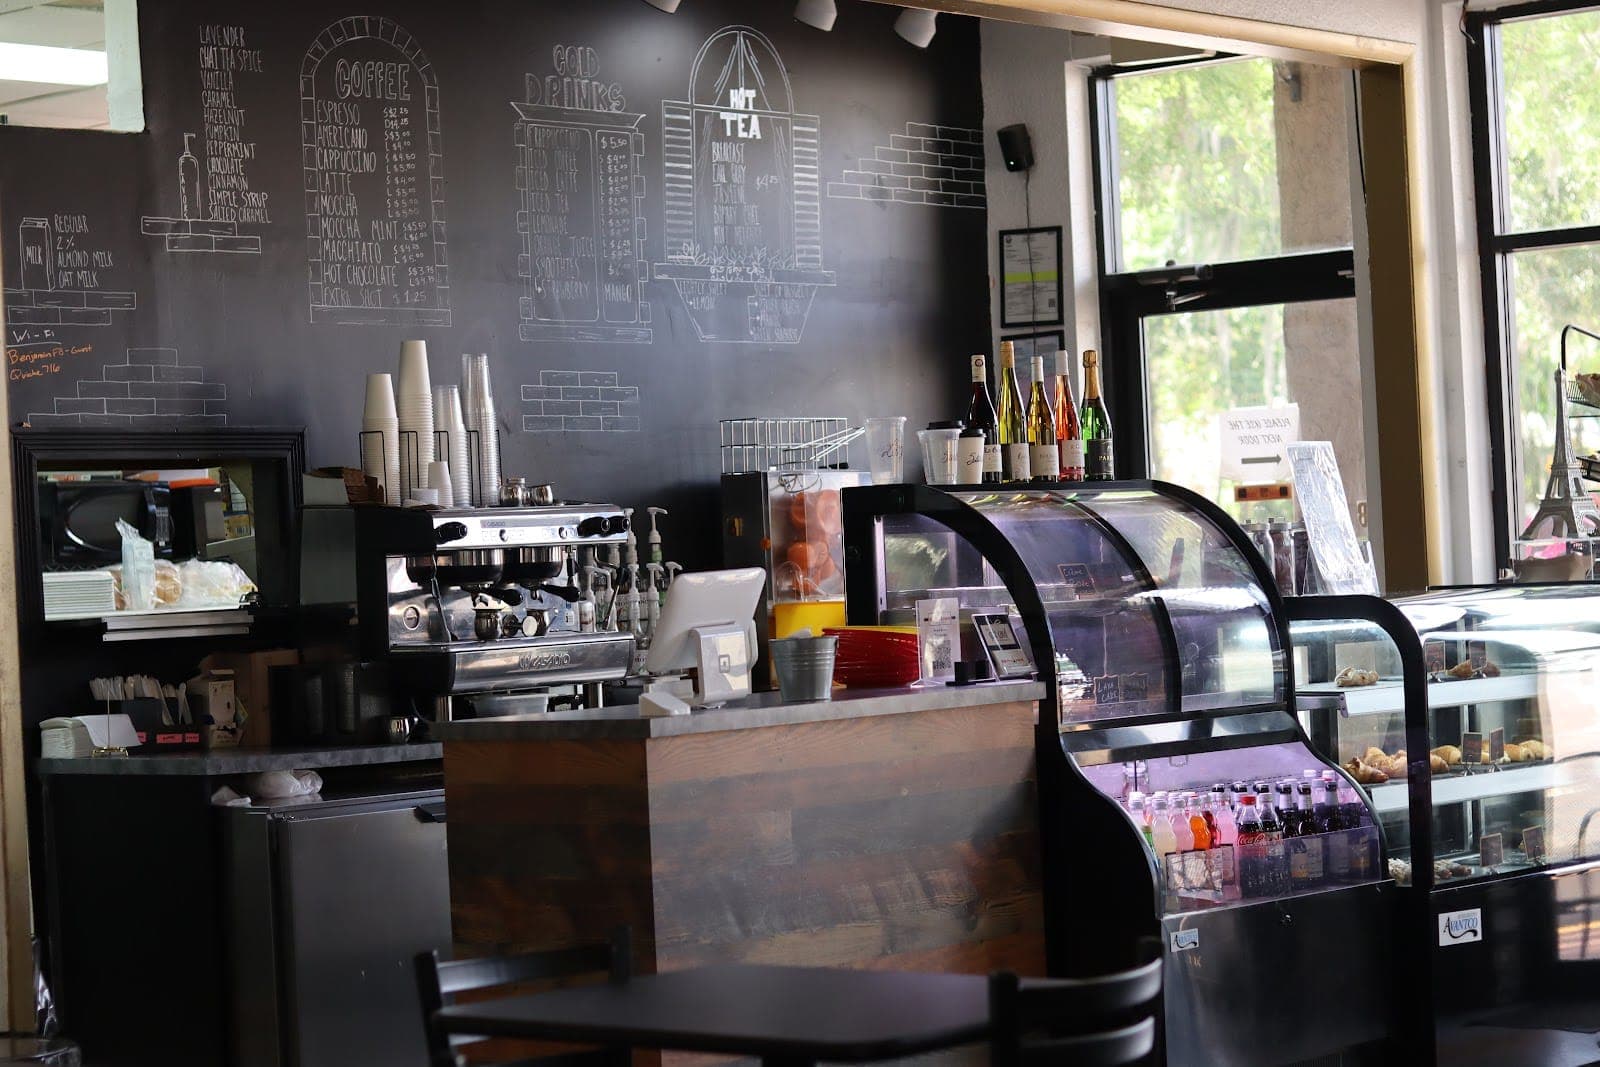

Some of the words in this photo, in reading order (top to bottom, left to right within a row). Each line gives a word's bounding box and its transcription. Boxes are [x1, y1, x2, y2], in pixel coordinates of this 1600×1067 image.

[199, 24, 245, 47] LAVENDER
[199, 46, 218, 70] CHAI
[220, 47, 236, 71] TEA
[237, 49, 264, 73] SPICE
[553, 44, 600, 78] COLD
[200, 70, 234, 91] VANILLA
[335, 58, 410, 101] COFFEE
[202, 90, 237, 109] CARAMEL
[525, 72, 626, 112] DRINKS
[729, 87, 757, 110] HOT
[203, 107, 245, 127] HAZELNUT
[317, 99, 360, 126] ESPRESSO
[205, 124, 240, 142] PUMPKIN
[719, 112, 762, 139] TEA
[317, 125, 368, 149] AMERICANO
[206, 140, 256, 159] PEPPERMINT
[317, 147, 377, 173] CAPPUCCINO
[206, 157, 245, 175] CHOCOLATE
[208, 174, 249, 192] CINNAMON
[319, 171, 354, 196] LATTE
[208, 190, 238, 208] SIMPLE
[241, 191, 269, 208] SYRUP
[320, 195, 358, 217] MOCCHA
[54, 213, 89, 233] REGULAR
[208, 206, 237, 221] SALTED
[238, 207, 272, 224] CARAMEL
[321, 217, 361, 239] MOCCHA
[371, 219, 398, 242] MINT
[26, 246, 43, 265] MILK
[58, 250, 89, 268] ALMOND
[92, 251, 114, 268] MILK
[324, 239, 382, 264] MACCHIATO
[58, 270, 73, 288] OAT
[77, 270, 99, 288] MILK
[324, 263, 341, 284] HOT
[346, 264, 399, 287] CHOCOLATE
[324, 287, 352, 306] EXTRA
